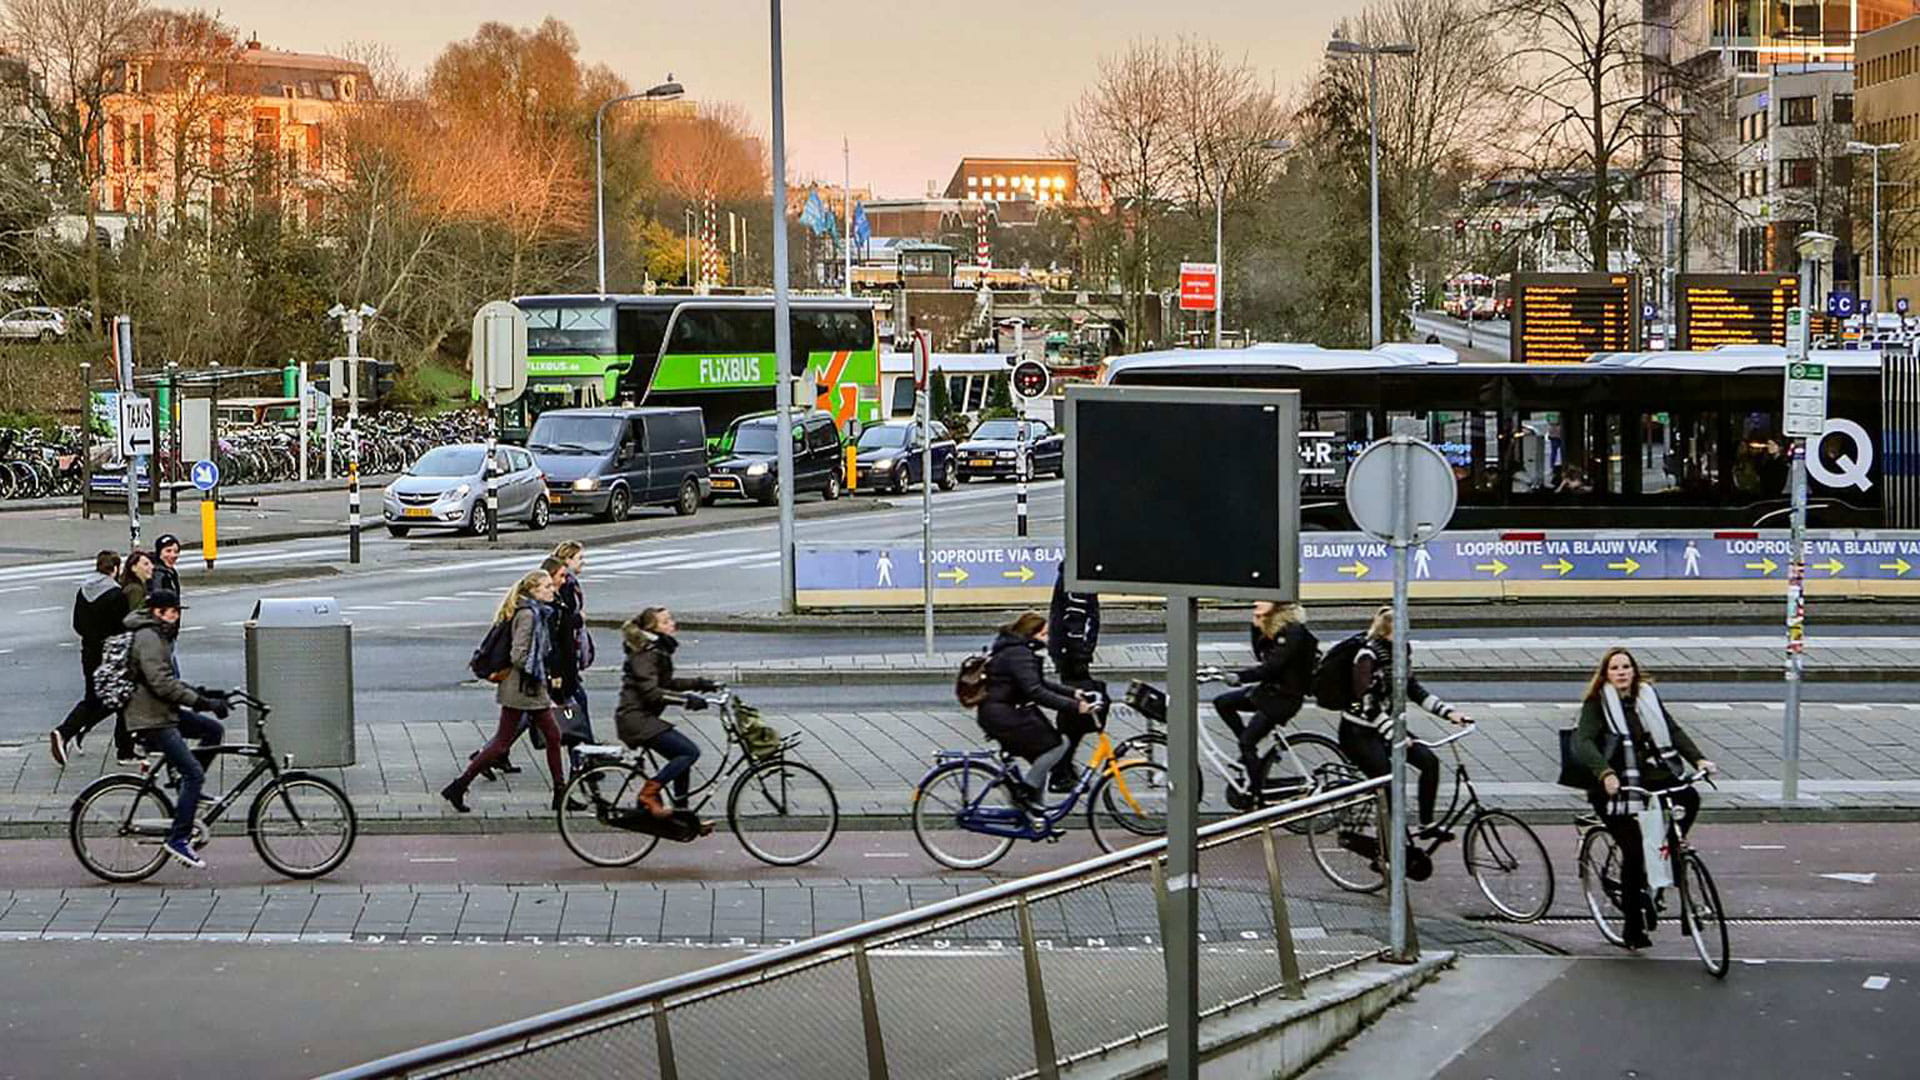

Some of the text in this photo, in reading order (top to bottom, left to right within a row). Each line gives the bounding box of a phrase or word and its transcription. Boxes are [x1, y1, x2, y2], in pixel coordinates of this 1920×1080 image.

[1643, 305, 1654, 316] D
[1839, 297, 1851, 311] C
[1297, 442, 1332, 463] +R
[1804, 418, 1873, 493] Q
[1006, 548, 1031, 562] VIA
[1034, 548, 1065, 562] BLA
[1303, 543, 1388, 558] BLAUW VAK
[1456, 539, 1658, 557] LOOPROUTE VIA BLAUW VAK
[1726, 540, 1920, 555] LOOPROE VIA BLAUW VA
